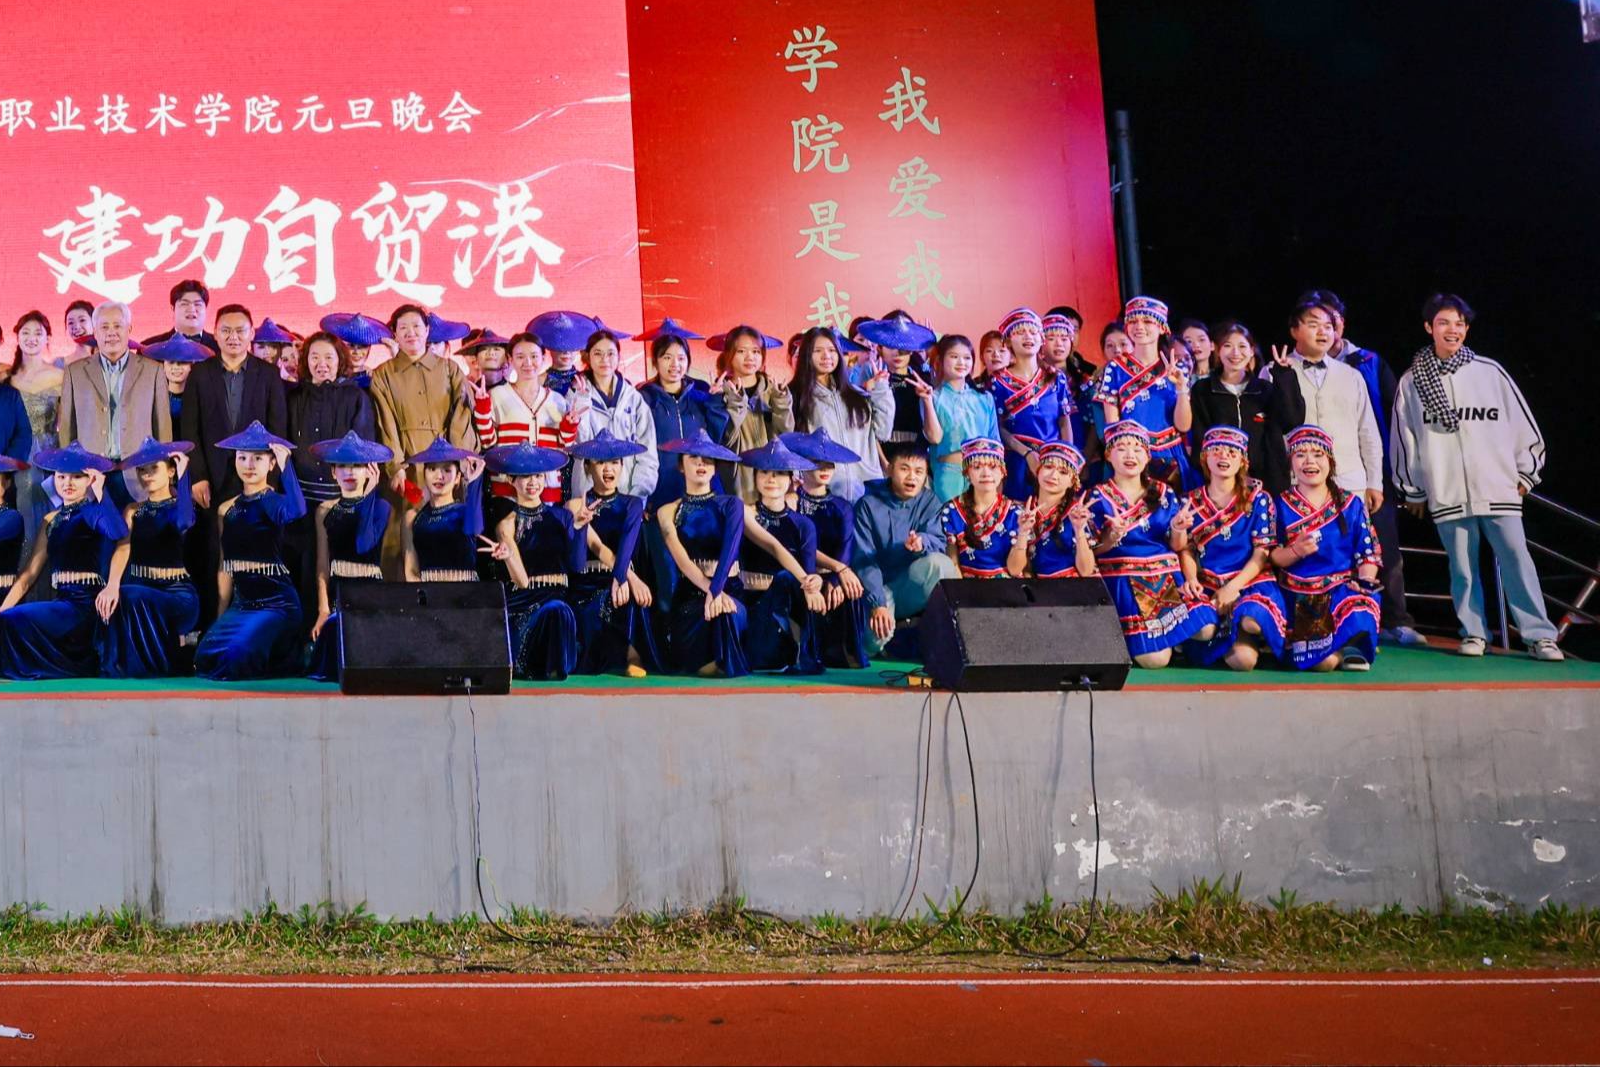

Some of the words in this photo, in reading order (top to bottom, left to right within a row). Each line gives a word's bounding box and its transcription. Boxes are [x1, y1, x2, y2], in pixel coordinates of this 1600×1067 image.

[37, 181, 564, 307] 建功自贸港
[878, 66, 955, 342] 我爱我
